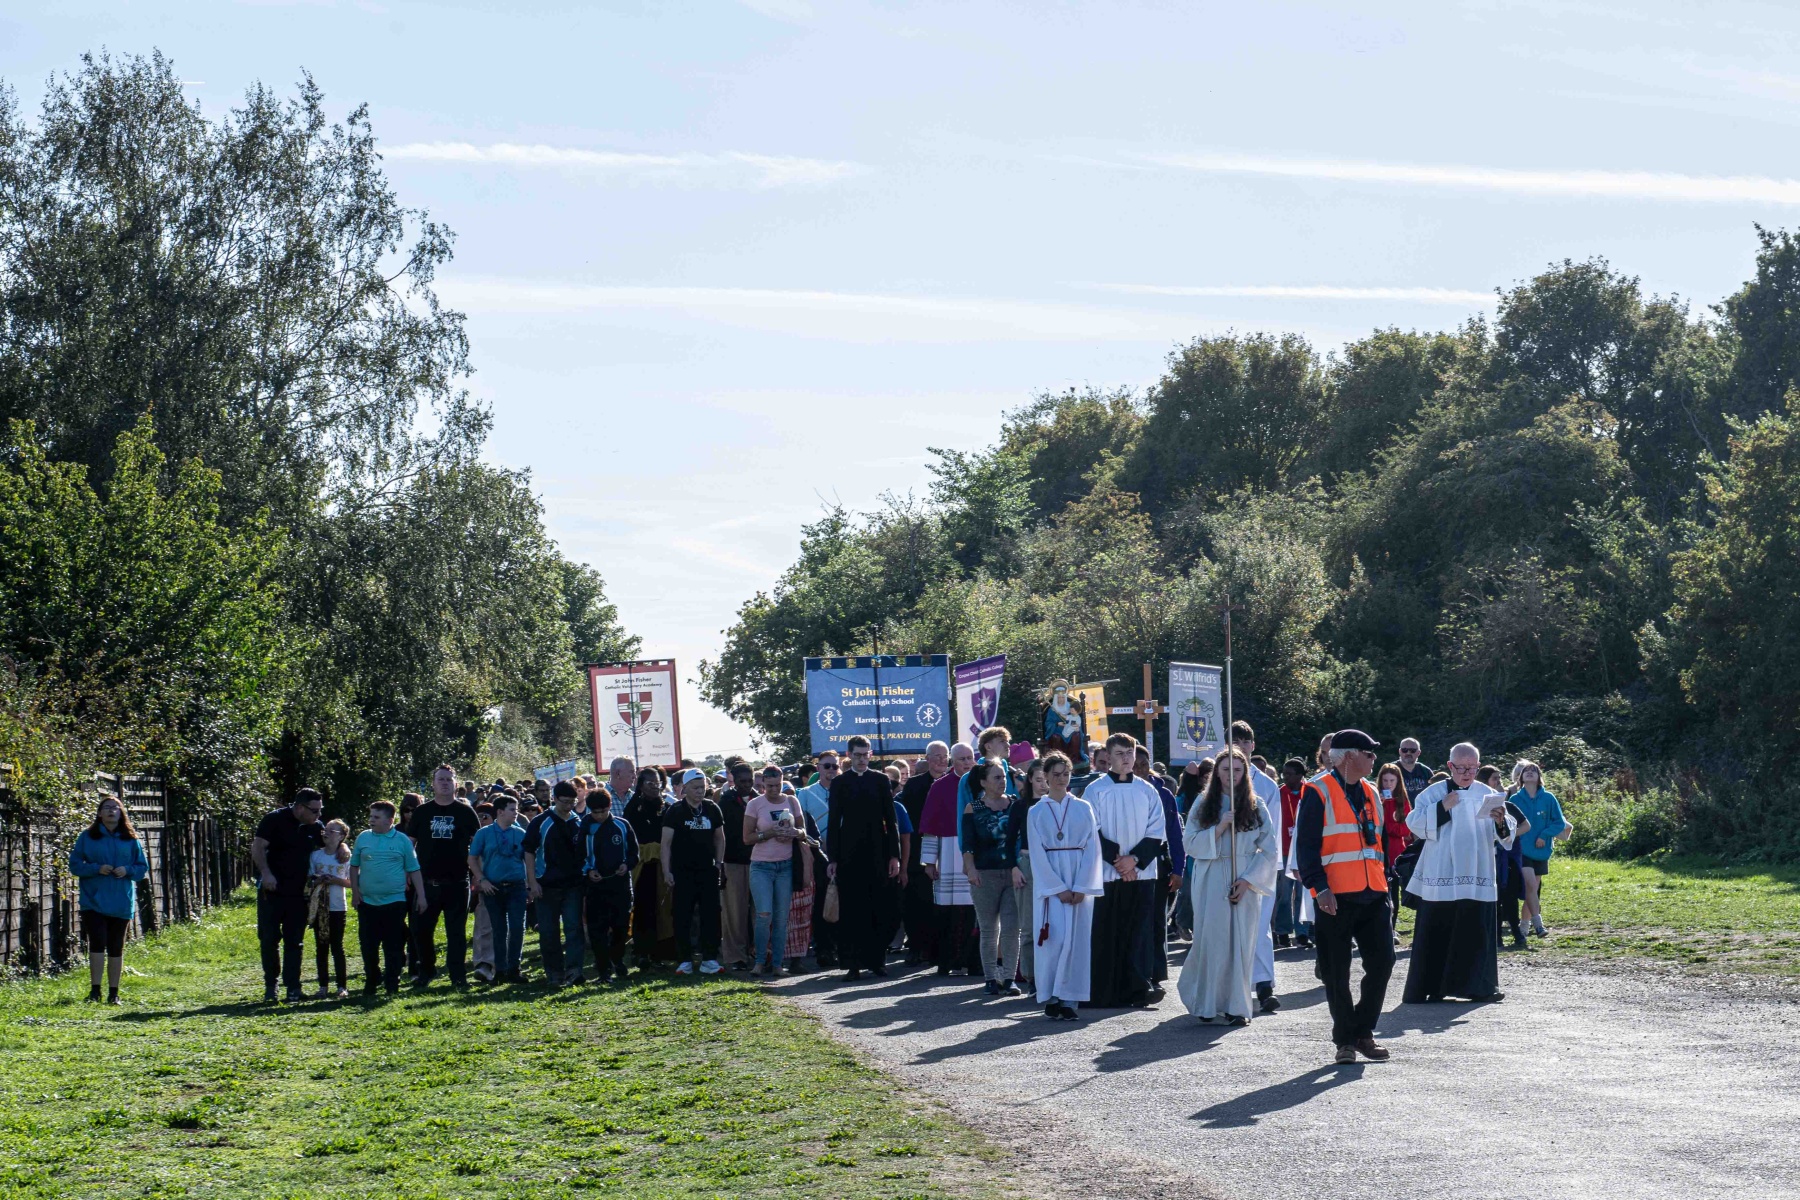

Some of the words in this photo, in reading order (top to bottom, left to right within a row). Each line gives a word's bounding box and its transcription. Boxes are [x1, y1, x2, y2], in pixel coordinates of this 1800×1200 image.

[842, 688, 853, 698] St
[855, 686, 878, 698] John
[882, 686, 914, 696] Fisher
[842, 698, 872, 706] Catholic
[872, 698, 890, 707] High
[854, 716, 891, 724] Harrogate,
